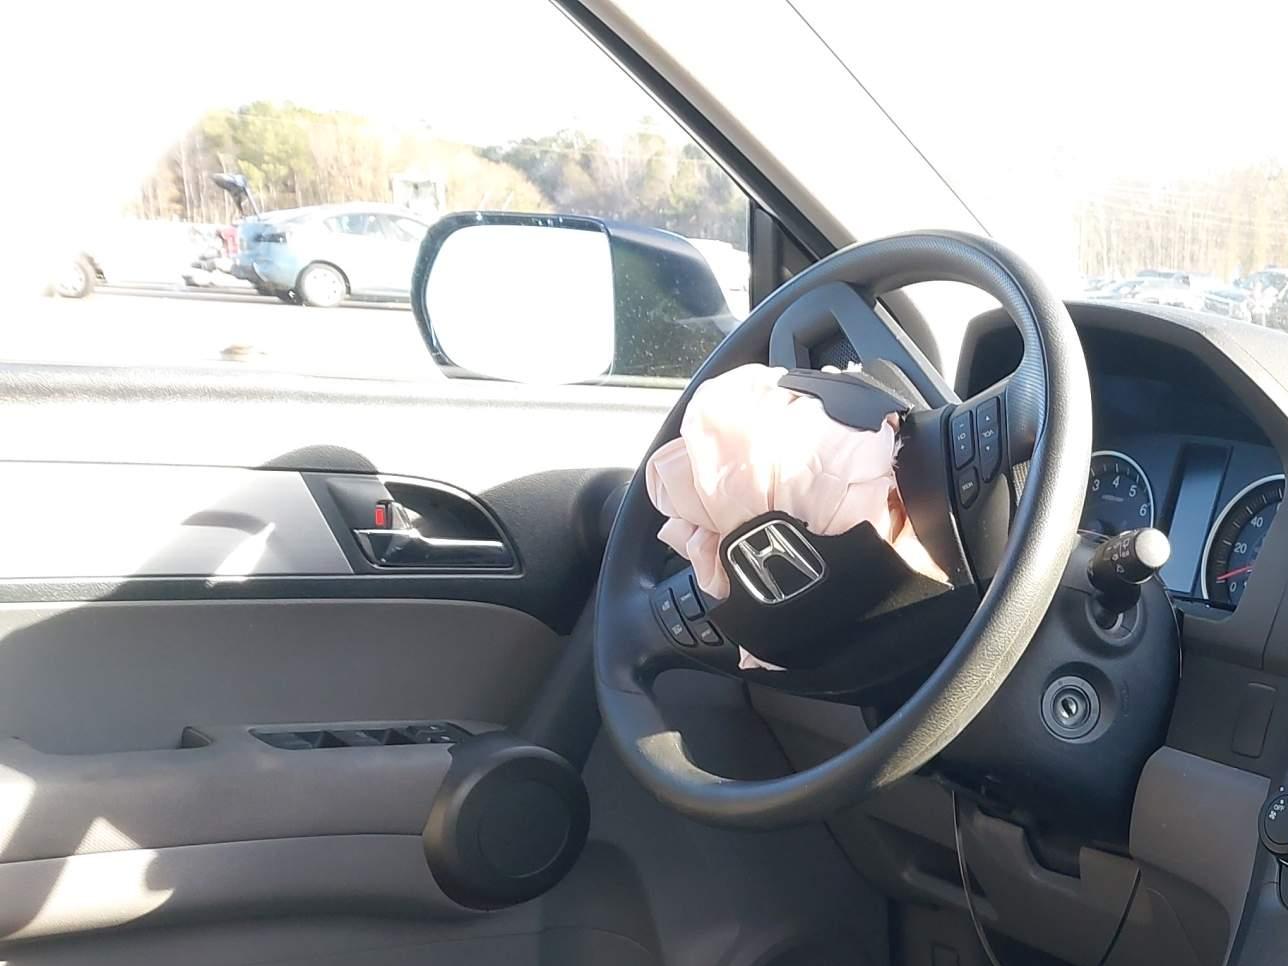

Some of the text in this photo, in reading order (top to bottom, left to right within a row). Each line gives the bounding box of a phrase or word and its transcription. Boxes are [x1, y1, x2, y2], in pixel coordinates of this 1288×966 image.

[1091, 475, 1148, 516] 3 4 5 6
[1250, 516, 1264, 528] 40
[1234, 542, 1248, 554] 20
[1229, 581, 1237, 593] 0
